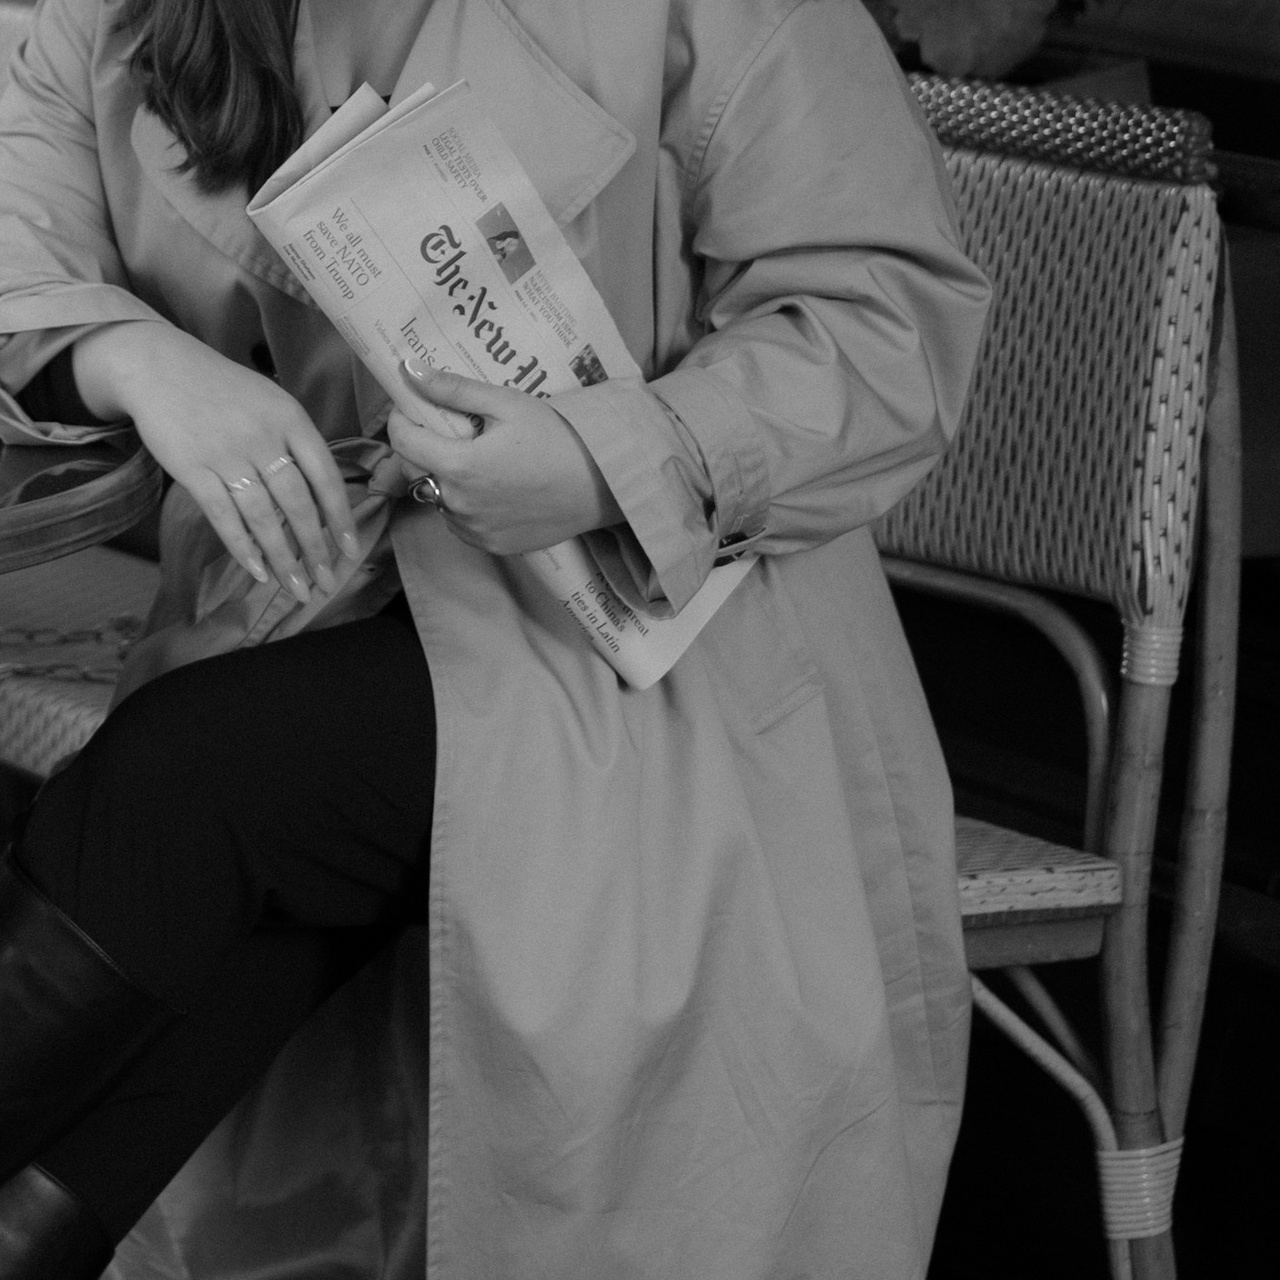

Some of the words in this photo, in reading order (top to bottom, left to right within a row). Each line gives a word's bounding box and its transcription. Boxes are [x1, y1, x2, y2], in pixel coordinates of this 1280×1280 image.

[432, 137, 448, 160] CHILD
[445, 160, 467, 188] SAFETY
[439, 132, 456, 156] LEGAL
[454, 155, 471, 179] TESTS
[470, 179, 487, 202] OVER
[303, 230, 327, 260] from
[325, 257, 355, 300] Trump
[317, 221, 339, 247] save
[336, 245, 370, 286] NATO
[332, 207, 349, 231] We
[346, 233, 363, 248] all
[357, 248, 382, 278] must
[420, 225, 469, 297] The
[453, 286, 516, 365] New
[529, 275, 563, 321] NARCISSISM
[561, 321, 578, 341] ISN'T
[535, 270, 552, 293] MYTH
[400, 316, 436, 369] Iran's
[523, 281, 540, 305] WHAT
[539, 305, 554, 323] YOU
[553, 323, 572, 348] THINK
[558, 599, 595, 642] America
[571, 591, 590, 612] ties
[586, 610, 599, 625] in
[595, 622, 621, 654] Latin
[586, 579, 599, 593] to
[596, 589, 627, 630] China's
